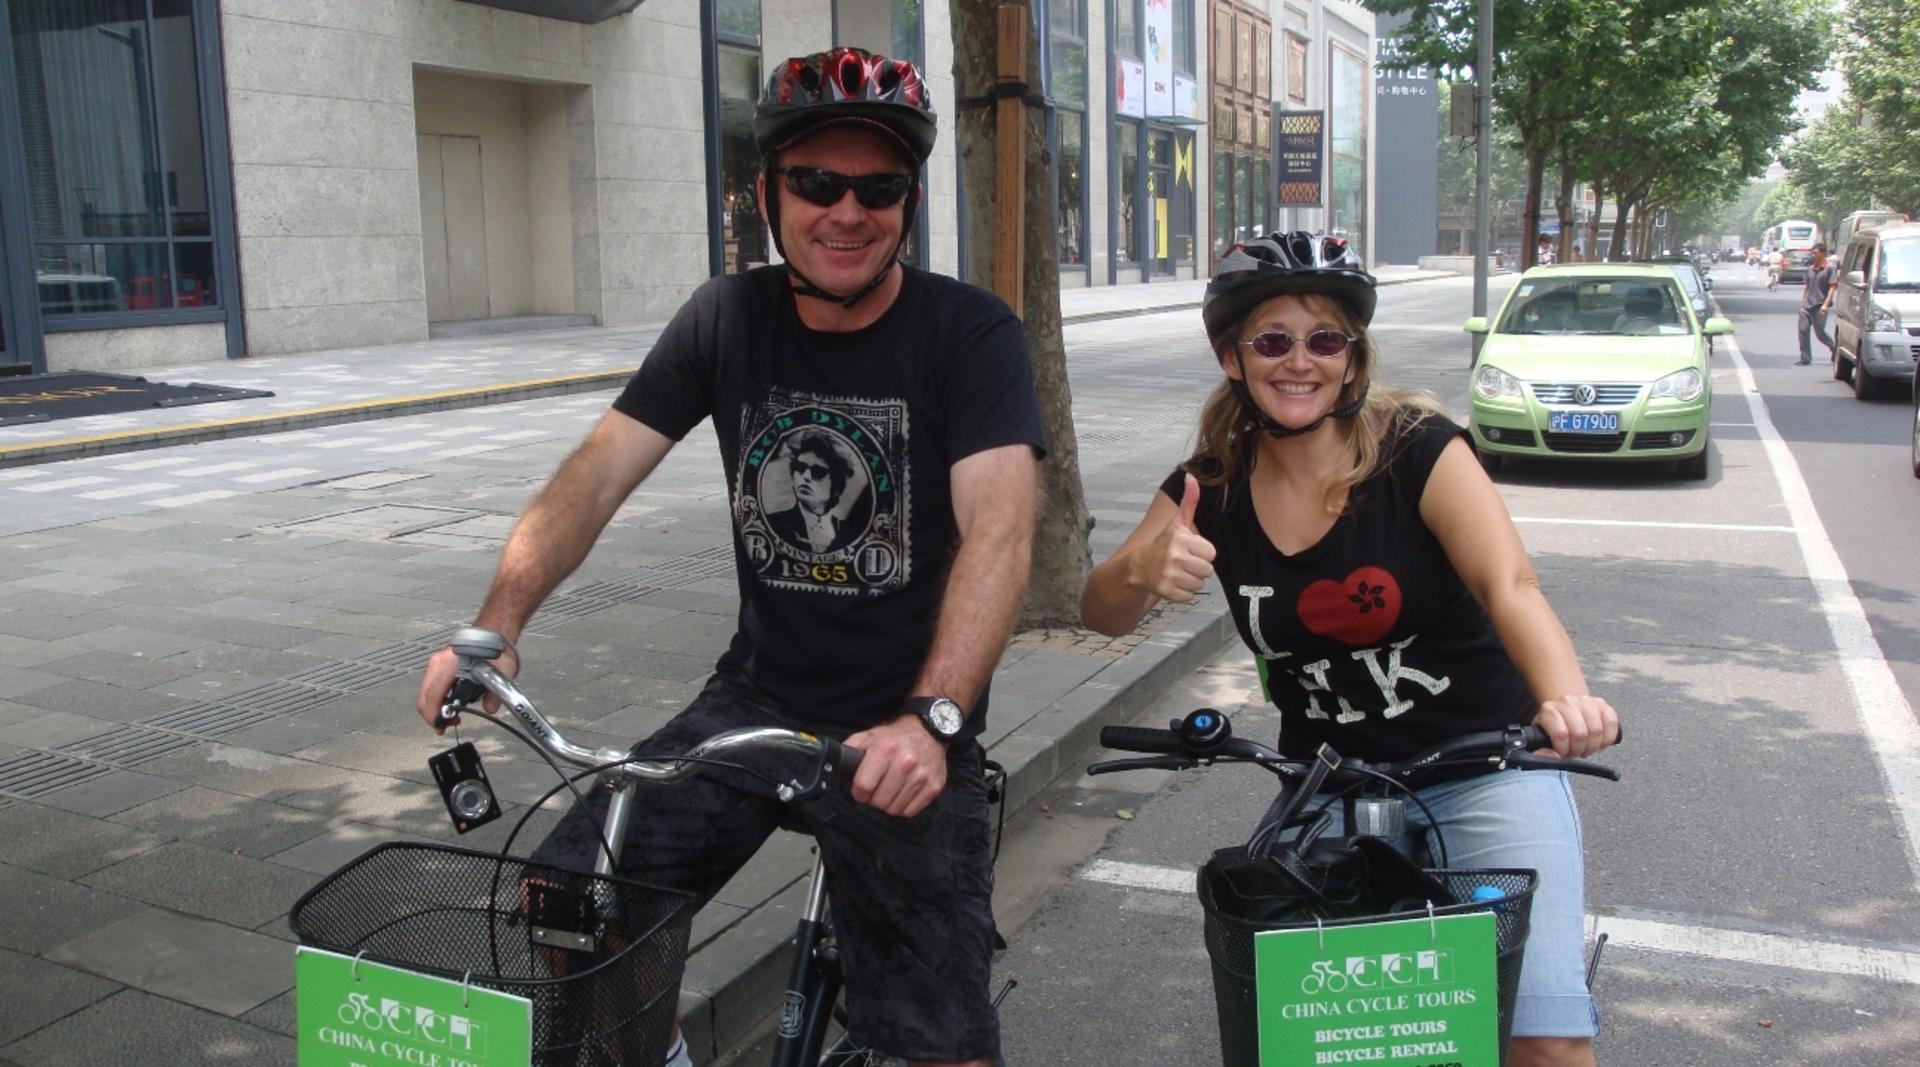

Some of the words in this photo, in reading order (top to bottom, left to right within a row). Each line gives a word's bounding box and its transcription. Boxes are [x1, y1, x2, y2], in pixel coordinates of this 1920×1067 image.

[1572, 414, 1617, 430] G7900
[748, 416, 795, 467] BOB
[810, 410, 891, 494] DYLAN
[779, 558, 849, 583] 1965
[1290, 633, 1452, 725] HK
[1281, 1001, 1342, 1020] CHINA
[1346, 996, 1409, 1013] CYCLE
[1415, 988, 1477, 1007] TOURS
[1314, 1025, 1385, 1044] BICYCLE
[1389, 1019, 1448, 1037] TOURS
[318, 1026, 376, 1054] CHINA
[380, 1040, 441, 1067] CYCLE
[1315, 1046, 1386, 1065] BICYCLE
[1390, 1039, 1459, 1059] RENTAL
